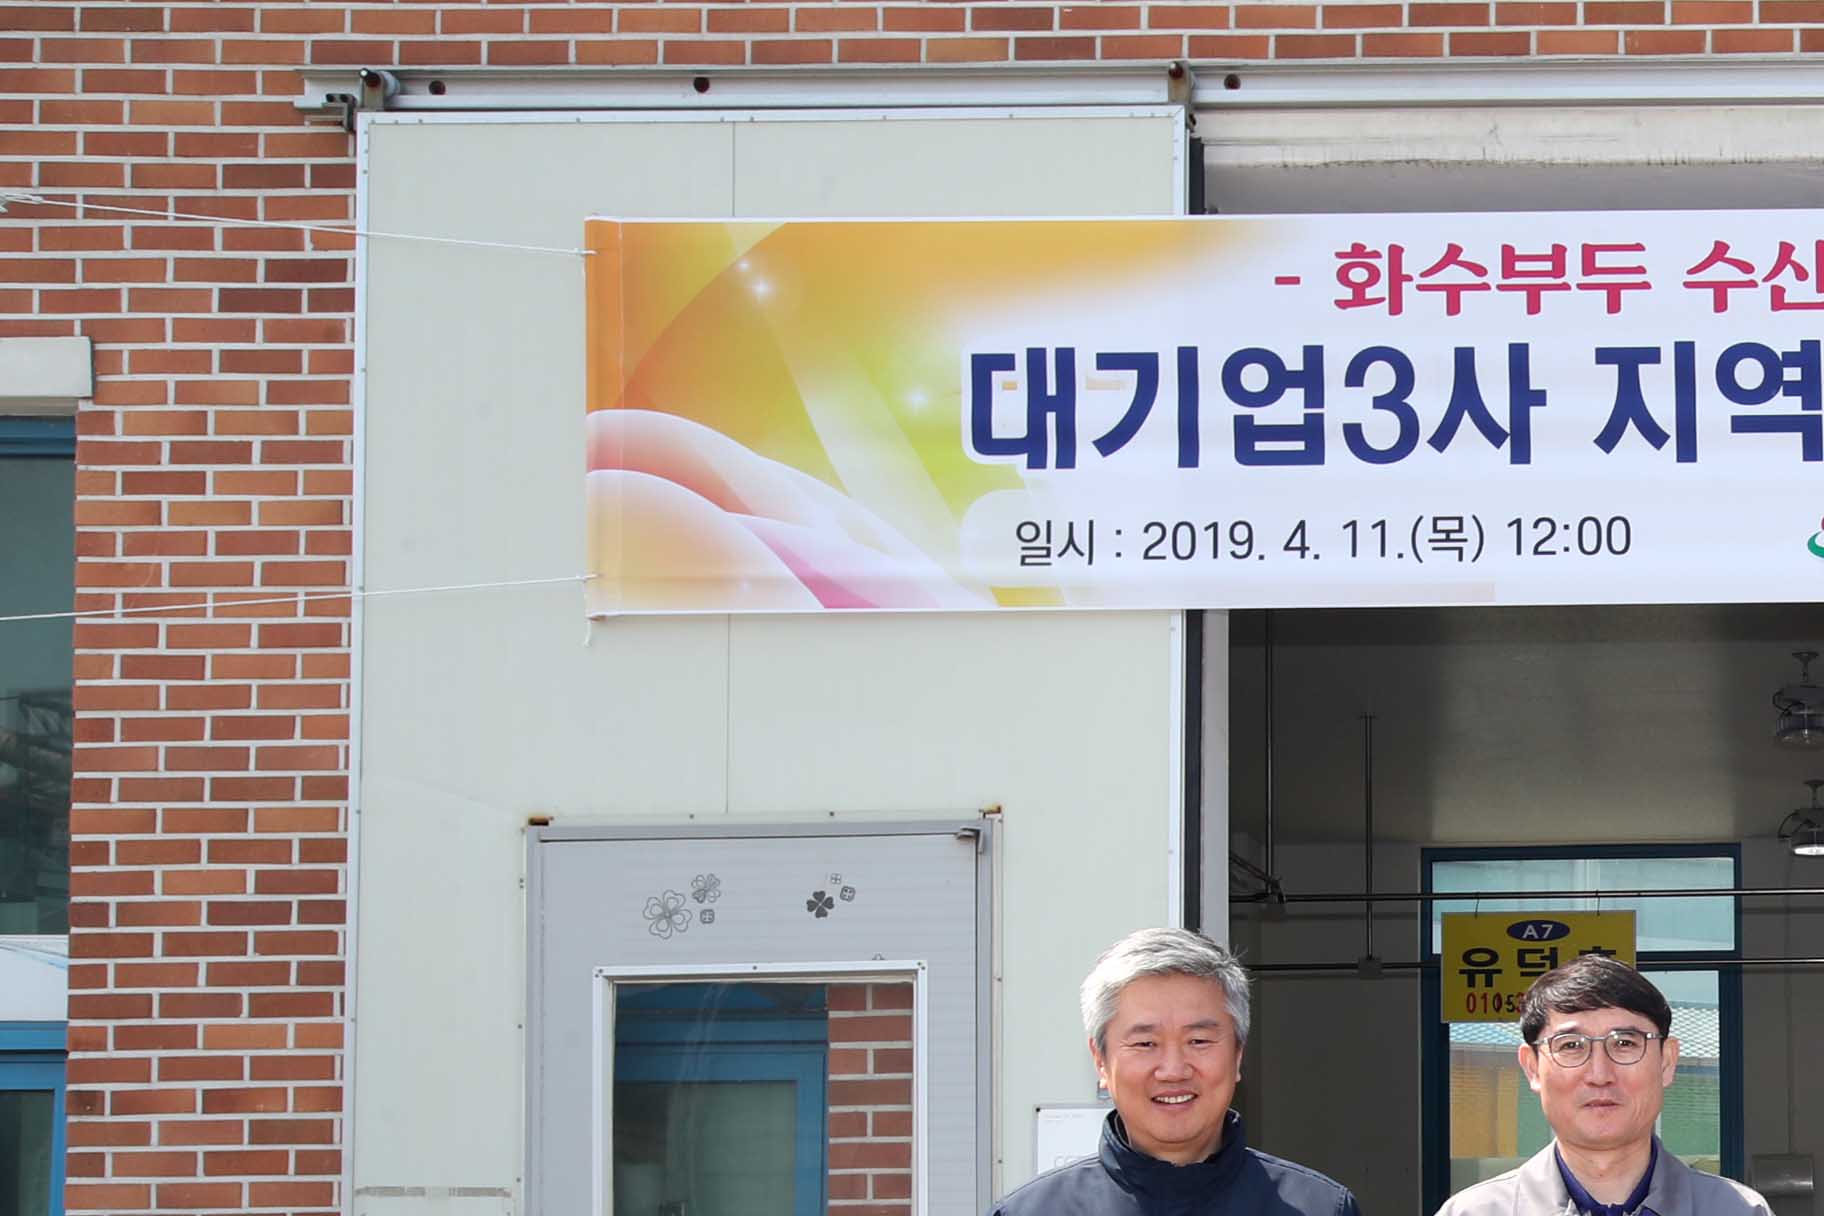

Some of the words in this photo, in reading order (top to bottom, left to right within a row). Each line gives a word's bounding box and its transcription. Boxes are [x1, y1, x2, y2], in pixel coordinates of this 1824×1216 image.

[1333, 241, 1653, 317] 화수부두
[970, 343, 1547, 470] 대기업3사
[1015, 518, 1097, 567] 일시
[1142, 519, 1266, 562] 2019.
[1282, 519, 1321, 561] 4.
[1341, 514, 1485, 564] 11.(목)
[1506, 515, 1632, 557] 12:00
[1523, 924, 1554, 939] A7
